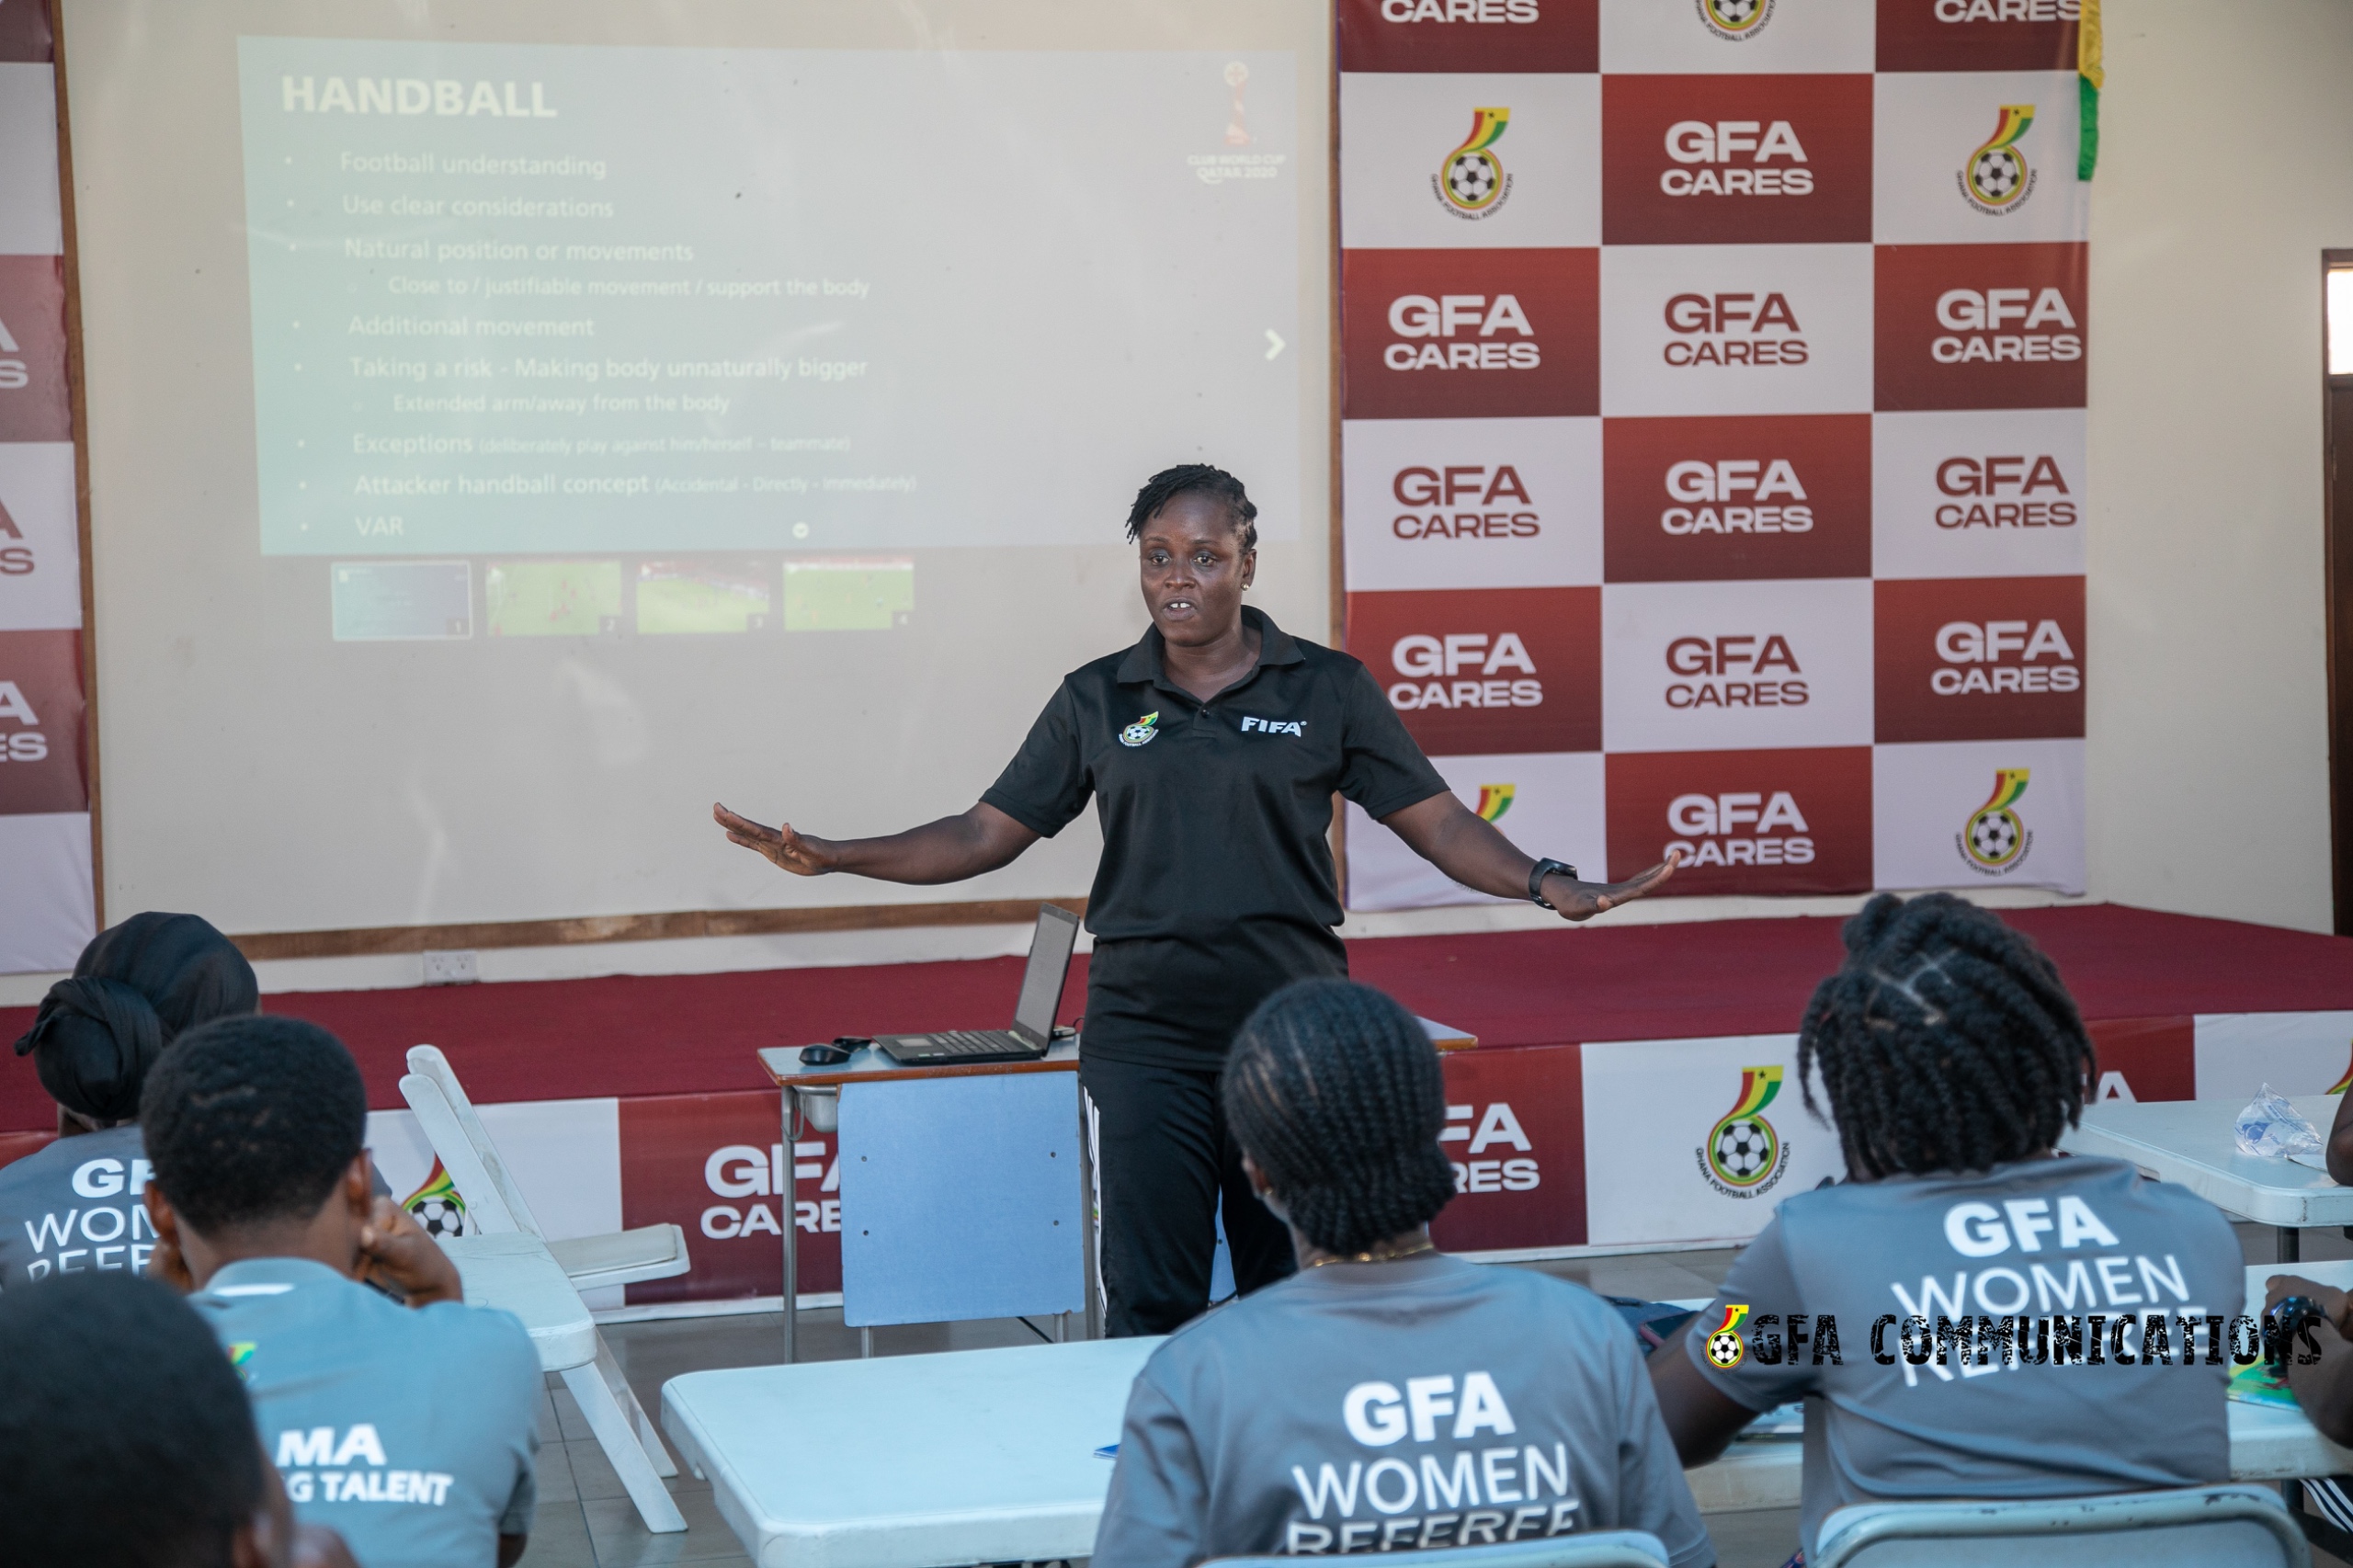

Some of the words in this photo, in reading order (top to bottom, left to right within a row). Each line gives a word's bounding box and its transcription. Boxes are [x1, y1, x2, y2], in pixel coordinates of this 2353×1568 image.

[1381, 0, 1540, 23] CARES
[1934, 0, 2081, 22] CARES
[281, 75, 558, 118] HANDBALL
[1665, 120, 1808, 164] GFA
[341, 151, 435, 174] Football
[442, 154, 607, 181] understanding
[1660, 168, 1814, 196] CARES
[343, 194, 383, 215] Use
[391, 194, 445, 216] clear
[451, 196, 614, 219] considerations
[345, 238, 430, 259] Natural
[438, 239, 529, 263] position
[535, 244, 559, 261] or
[566, 243, 694, 262] movements
[388, 276, 440, 294] Close
[447, 277, 468, 294] to
[484, 277, 582, 299] justifiable
[588, 278, 690, 296] movement
[707, 278, 780, 300] support
[786, 278, 818, 296] the
[824, 278, 870, 300] body
[347, 314, 468, 336] Additional
[476, 317, 596, 336] movement
[1388, 294, 1535, 338] GFA
[1664, 292, 1802, 334] GFA
[1936, 288, 2077, 331] GFA
[1383, 341, 1540, 370] CARES
[1663, 340, 1810, 367] CARES
[1931, 334, 2082, 364] CARES
[349, 356, 426, 382] Taking
[435, 360, 447, 378] a
[454, 356, 493, 378] risk
[515, 358, 598, 382] Making
[607, 357, 660, 382] body
[667, 357, 792, 381] unnaturally
[799, 357, 869, 381] bigger
[393, 393, 486, 413] Extended
[492, 393, 587, 416] arm/away
[593, 392, 639, 412] from
[645, 393, 676, 412] the
[683, 393, 731, 415] body
[353, 433, 472, 458] Exceptions
[576, 437, 608, 456] play
[355, 474, 451, 494] Attacker
[459, 473, 555, 494] handball
[563, 474, 649, 496] concept
[655, 475, 738, 494] (Accidental
[753, 475, 808, 494] Directly
[1392, 465, 1532, 506] GFA
[1665, 459, 1808, 503] GFA
[1936, 455, 2070, 497] GFA
[355, 516, 404, 537] VAR
[1392, 512, 1541, 540] CARES
[1661, 506, 1813, 536] CARES
[1934, 502, 2078, 530] CARES
[1391, 632, 1537, 678] GFA
[1665, 635, 1802, 676] GFA
[1935, 619, 2075, 664] GFA
[1388, 680, 1543, 710] CARES
[1665, 681, 1811, 709] CARES
[1930, 665, 2081, 696] CARES
[1667, 791, 1809, 836] GFA
[1664, 836, 1815, 869] CARES
[1437, 1102, 1533, 1153] FA
[72, 1158, 156, 1198] GF
[1449, 1157, 1540, 1194] RES
[1696, 1147, 1711, 1182] GHANA
[1711, 1179, 1753, 1199] FOOTBALL
[1756, 1142, 1790, 1197] ASSOCIATION
[25, 1204, 161, 1254] WOM
[700, 1199, 841, 1239] CARE
[1944, 1195, 2119, 1257] GFA
[1890, 1254, 2190, 1327] WOMEN
[1342, 1371, 1516, 1447] GFA
[320, 1470, 454, 1506] TALENT
[1290, 1442, 1569, 1520] WOMEN
